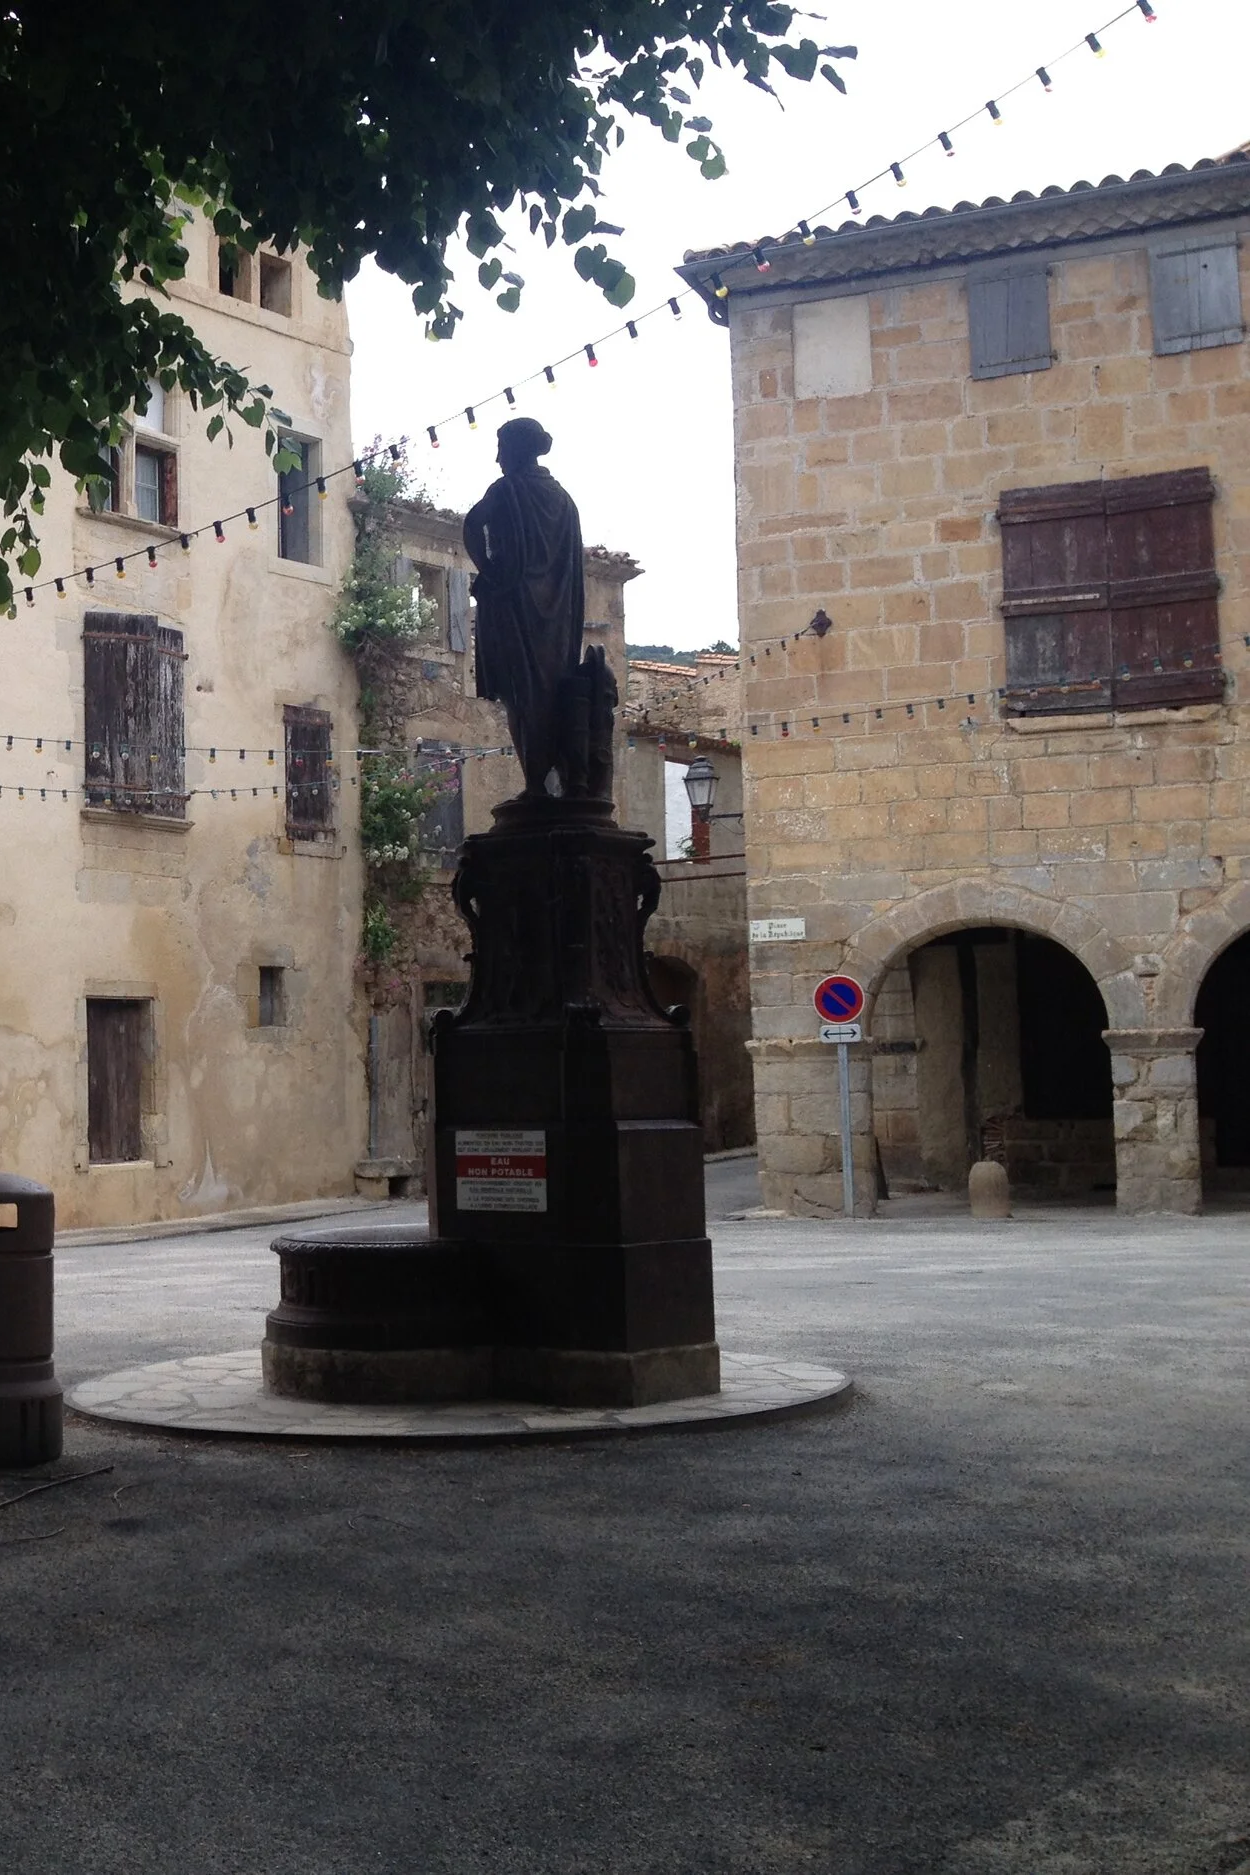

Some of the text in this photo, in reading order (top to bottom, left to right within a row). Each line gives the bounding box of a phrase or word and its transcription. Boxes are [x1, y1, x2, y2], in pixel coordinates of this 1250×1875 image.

[490, 1157, 510, 1165] EAU
[468, 1168, 534, 1176] NON POTABLE
